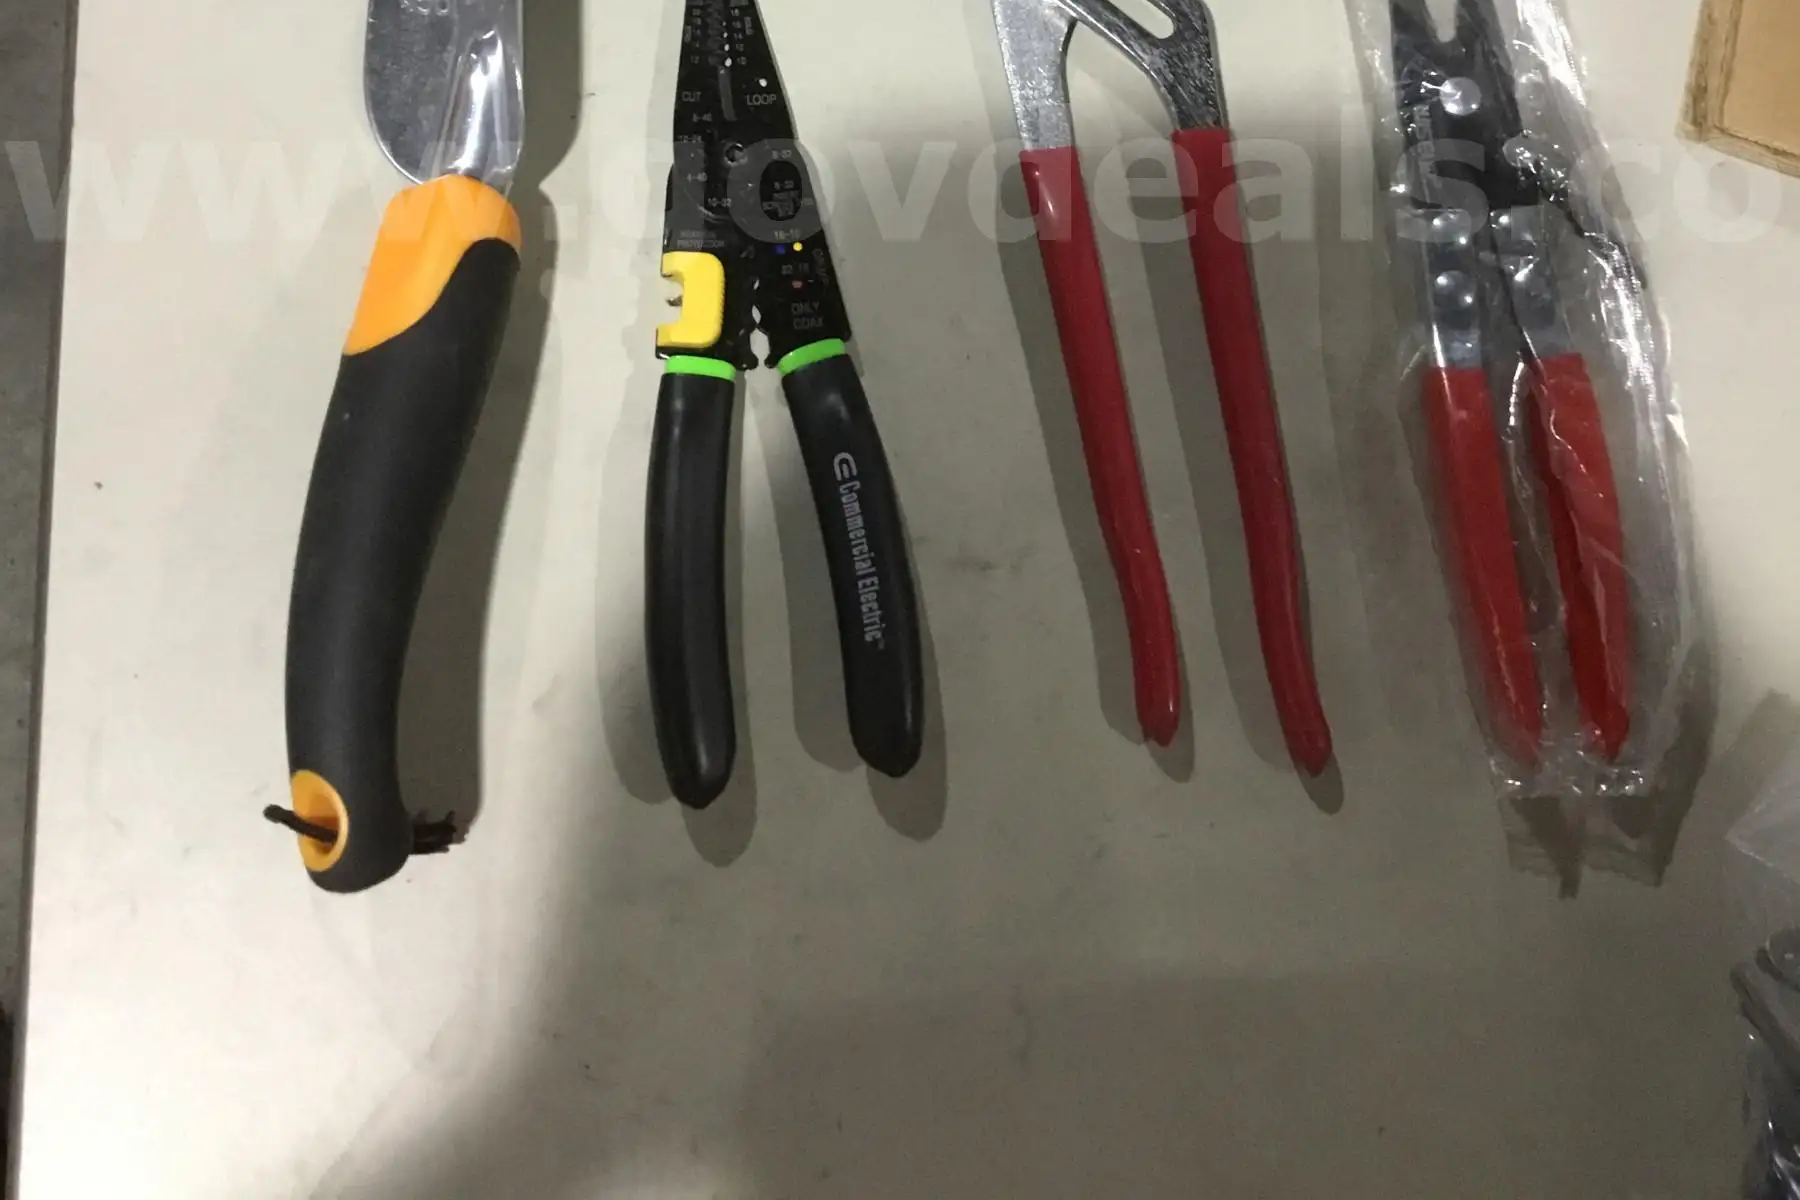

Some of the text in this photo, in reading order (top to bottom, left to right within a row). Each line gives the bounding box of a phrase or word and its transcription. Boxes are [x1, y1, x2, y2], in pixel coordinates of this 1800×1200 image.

[682, 91, 702, 102] CUT
[746, 94, 777, 106] LOOP
[839, 481, 886, 642] Commercial Electric
